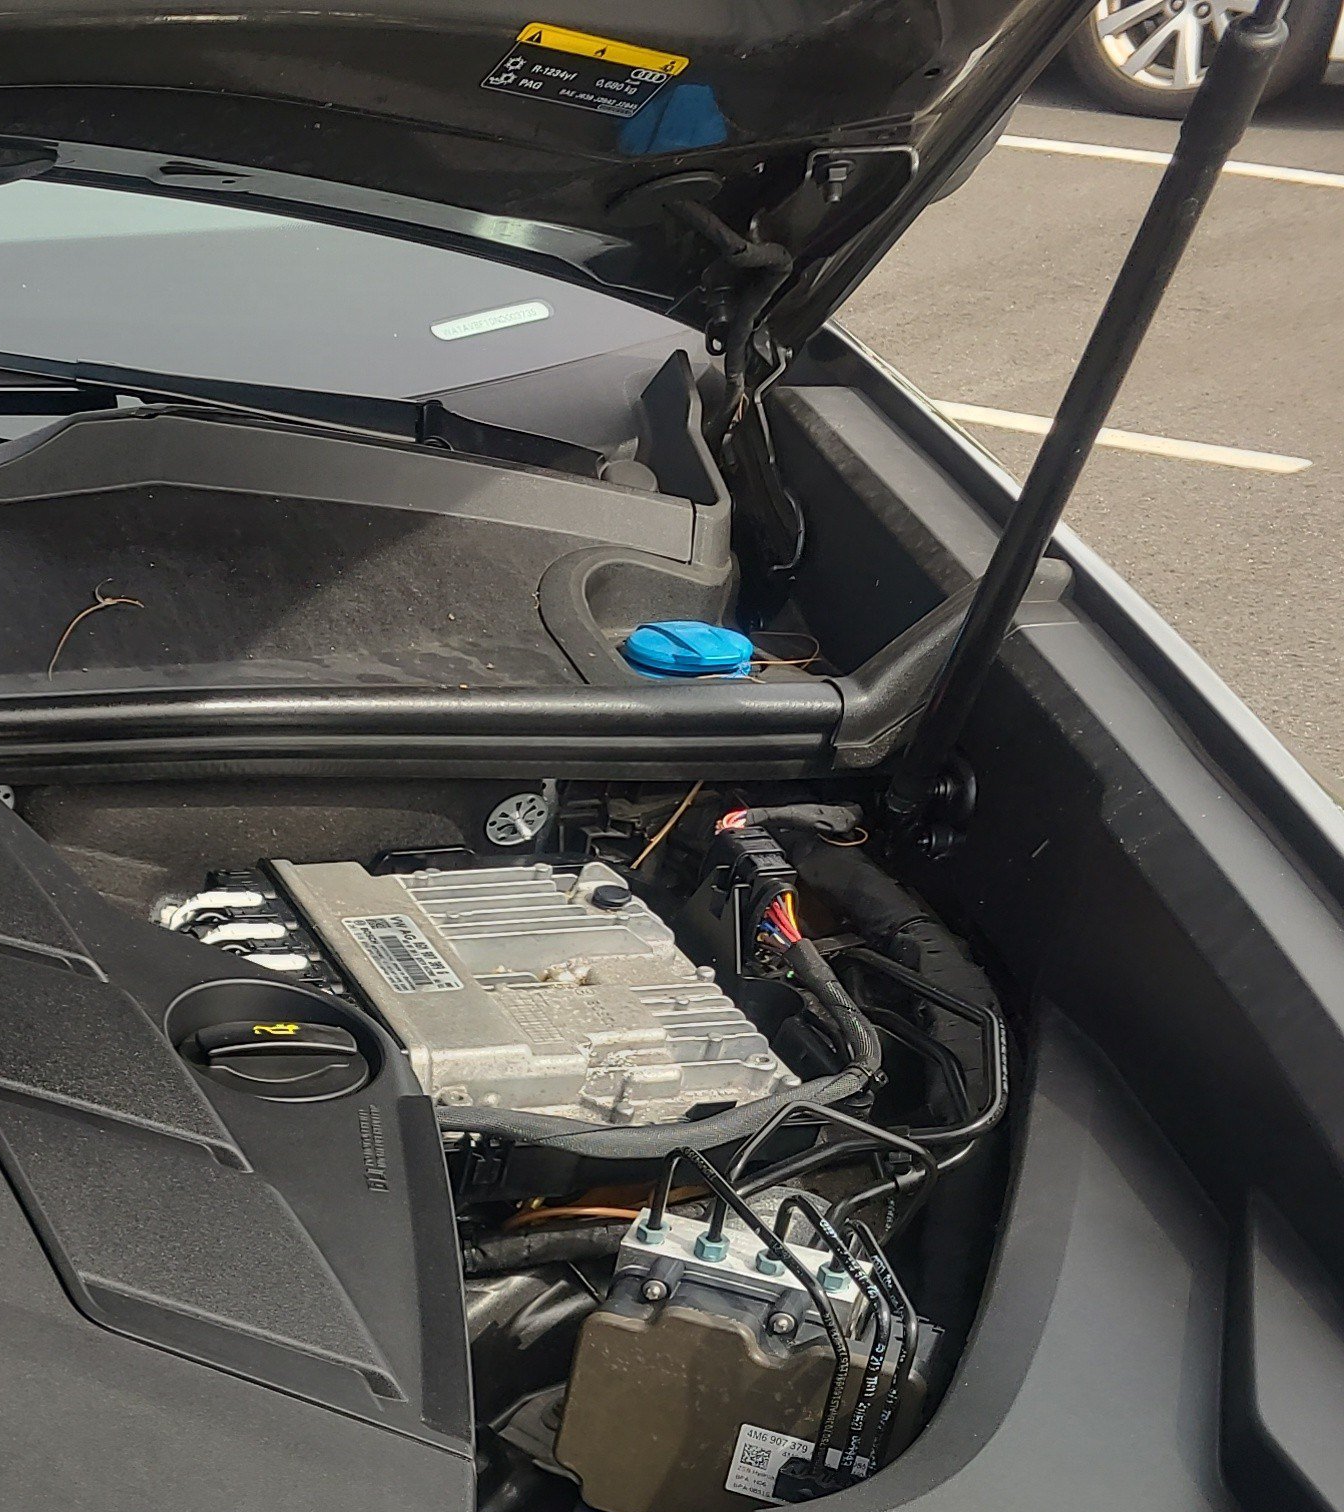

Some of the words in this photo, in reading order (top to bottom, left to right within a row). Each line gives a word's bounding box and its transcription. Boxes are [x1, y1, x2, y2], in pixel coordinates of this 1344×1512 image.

[531, 65, 577, 80] R-1234yf
[519, 79, 543, 89] PAG
[400, 930, 416, 940] AG
[747, 1429, 767, 1441] 4M6
[770, 1434, 788, 1446] 907
[790, 1441, 808, 1453] 379
